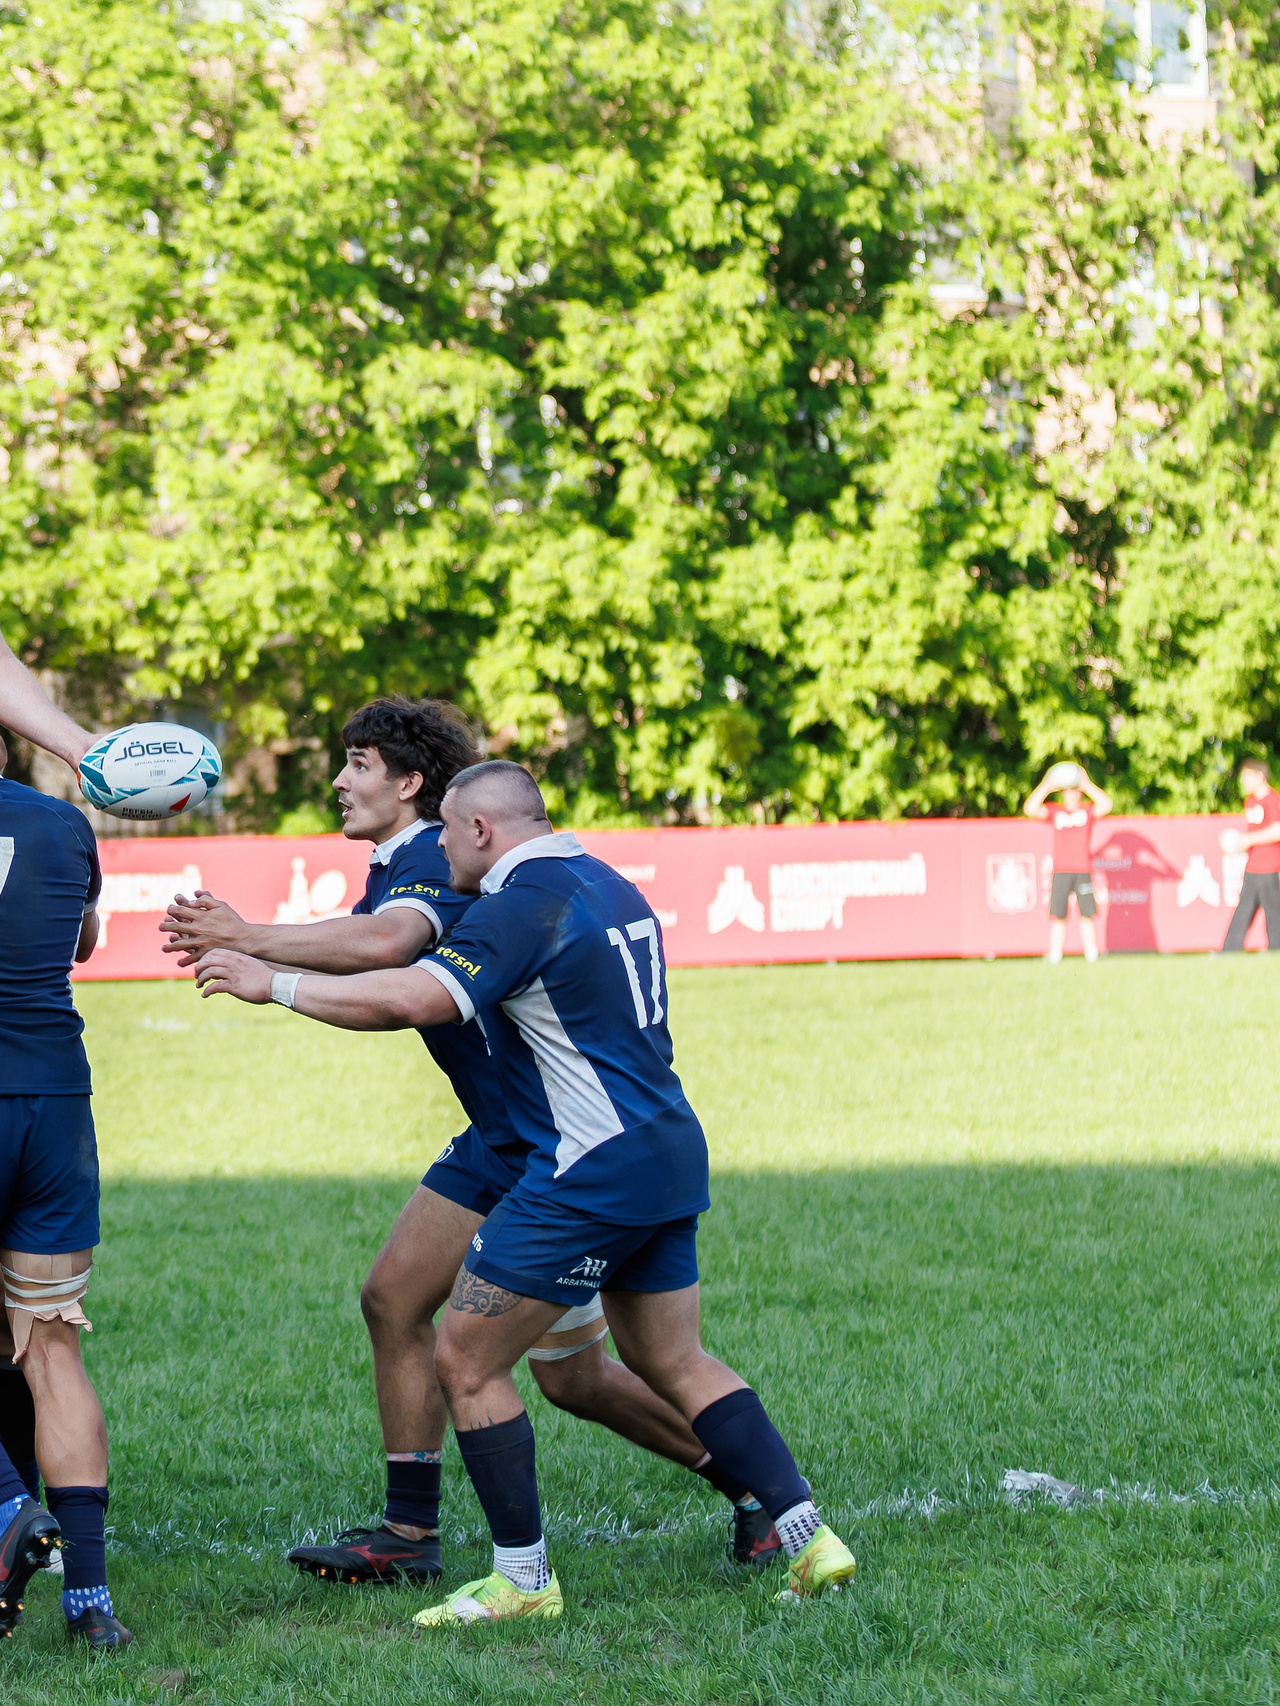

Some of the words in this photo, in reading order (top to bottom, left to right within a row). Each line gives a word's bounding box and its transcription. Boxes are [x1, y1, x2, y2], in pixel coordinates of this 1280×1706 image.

[114, 741, 194, 763] JÖGEL
[605, 916, 664, 1030] 17
[555, 1276, 601, 1289] ARBATHALL
